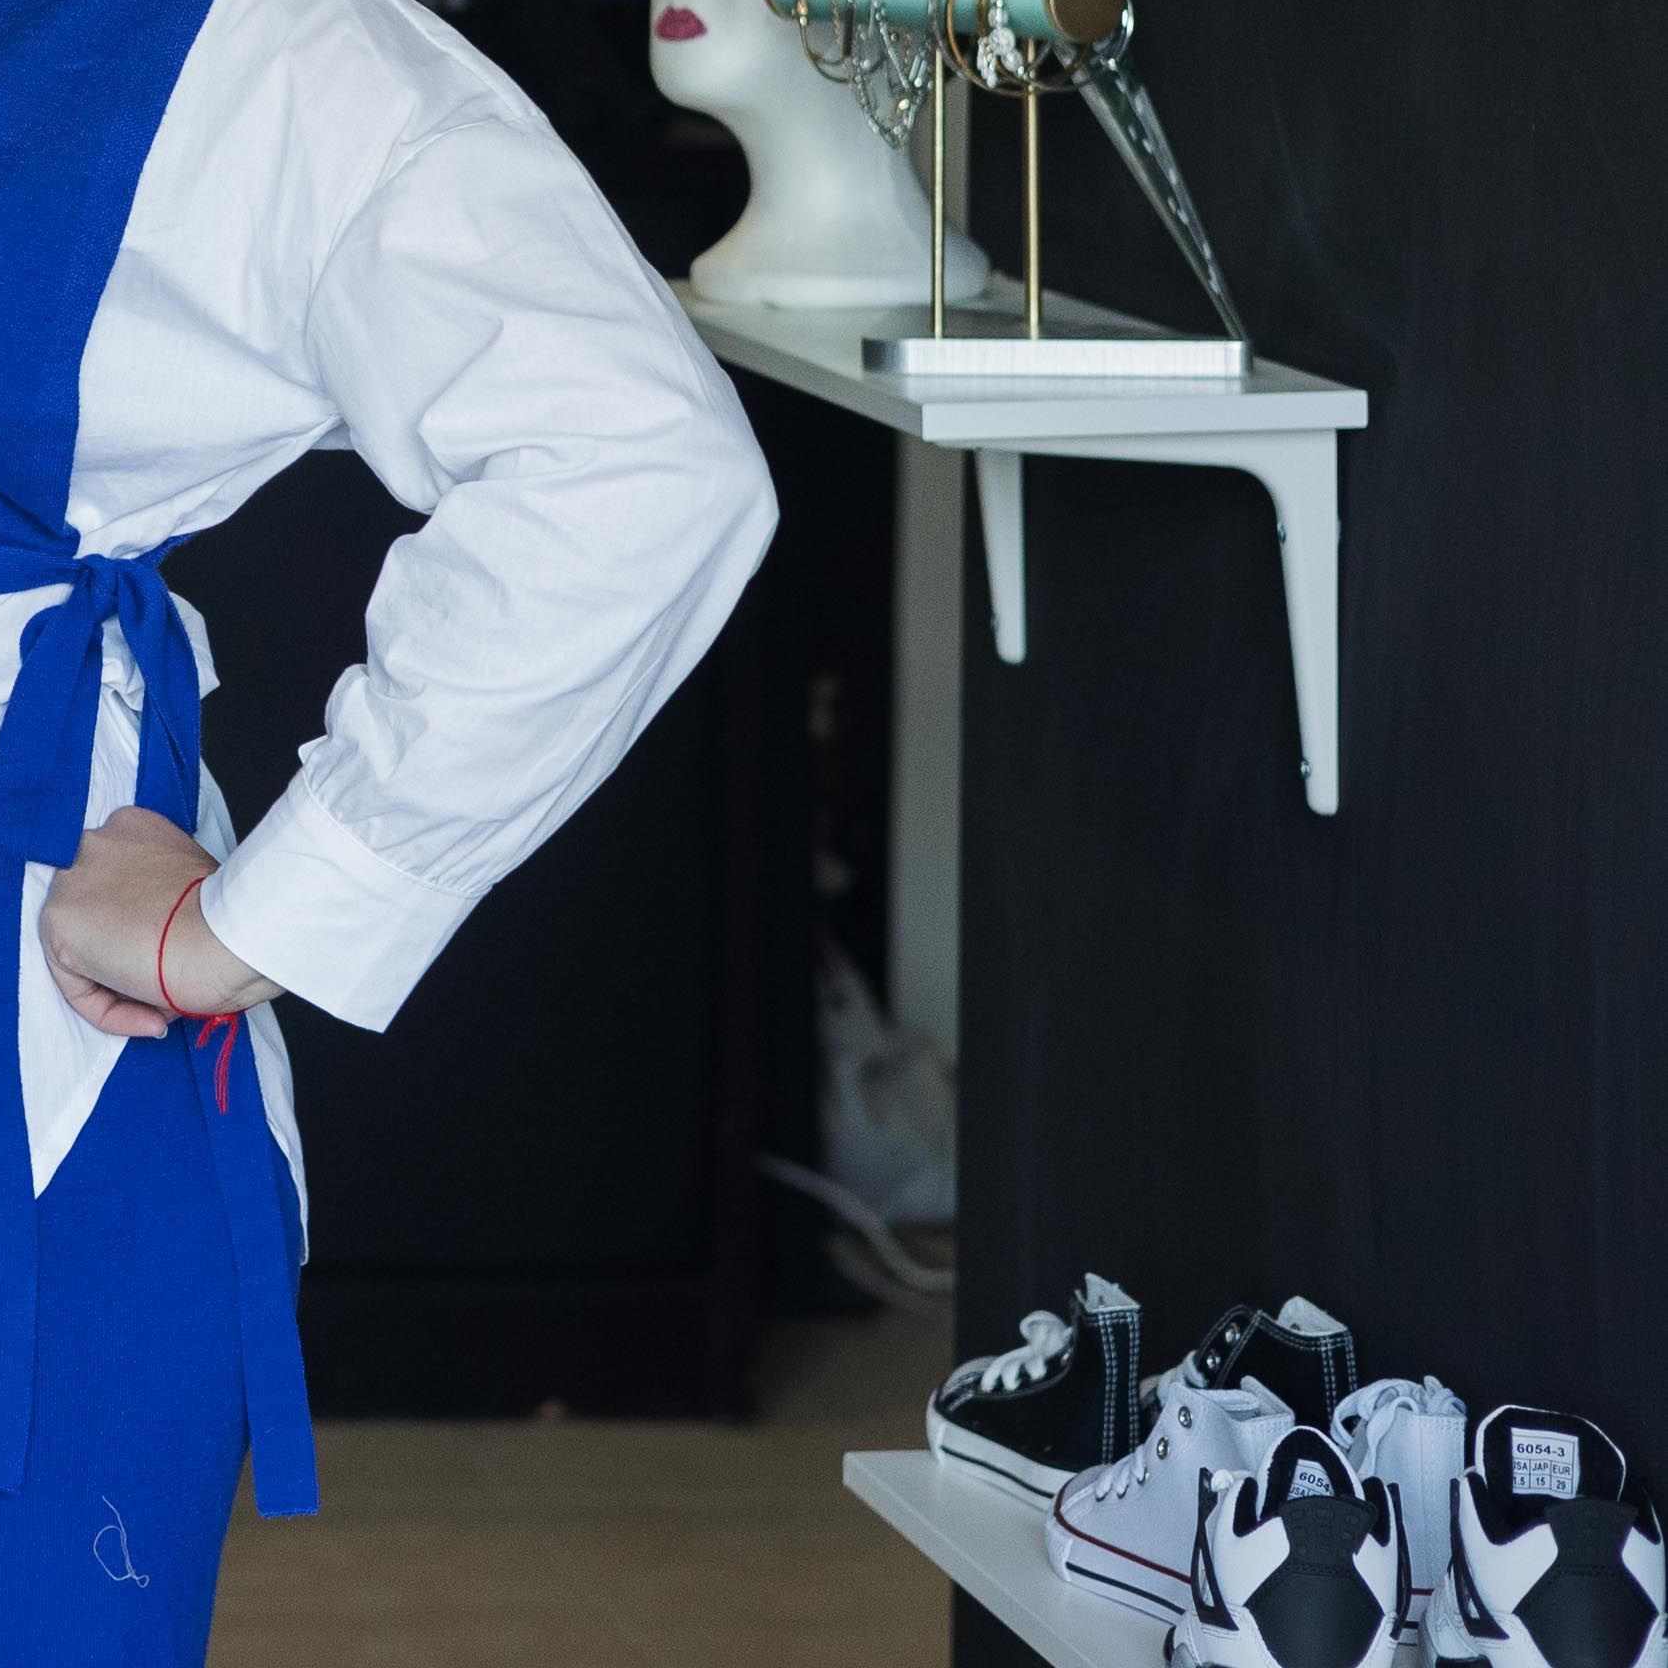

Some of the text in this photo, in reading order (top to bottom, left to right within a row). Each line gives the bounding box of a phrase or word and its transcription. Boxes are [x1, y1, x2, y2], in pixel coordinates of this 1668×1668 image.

[1516, 1443, 1565, 1457] 6054-3
[1532, 1462, 1549, 1472] JAP
[1552, 1464, 1571, 1476] EUR
[1536, 1477, 1546, 1486] 15
